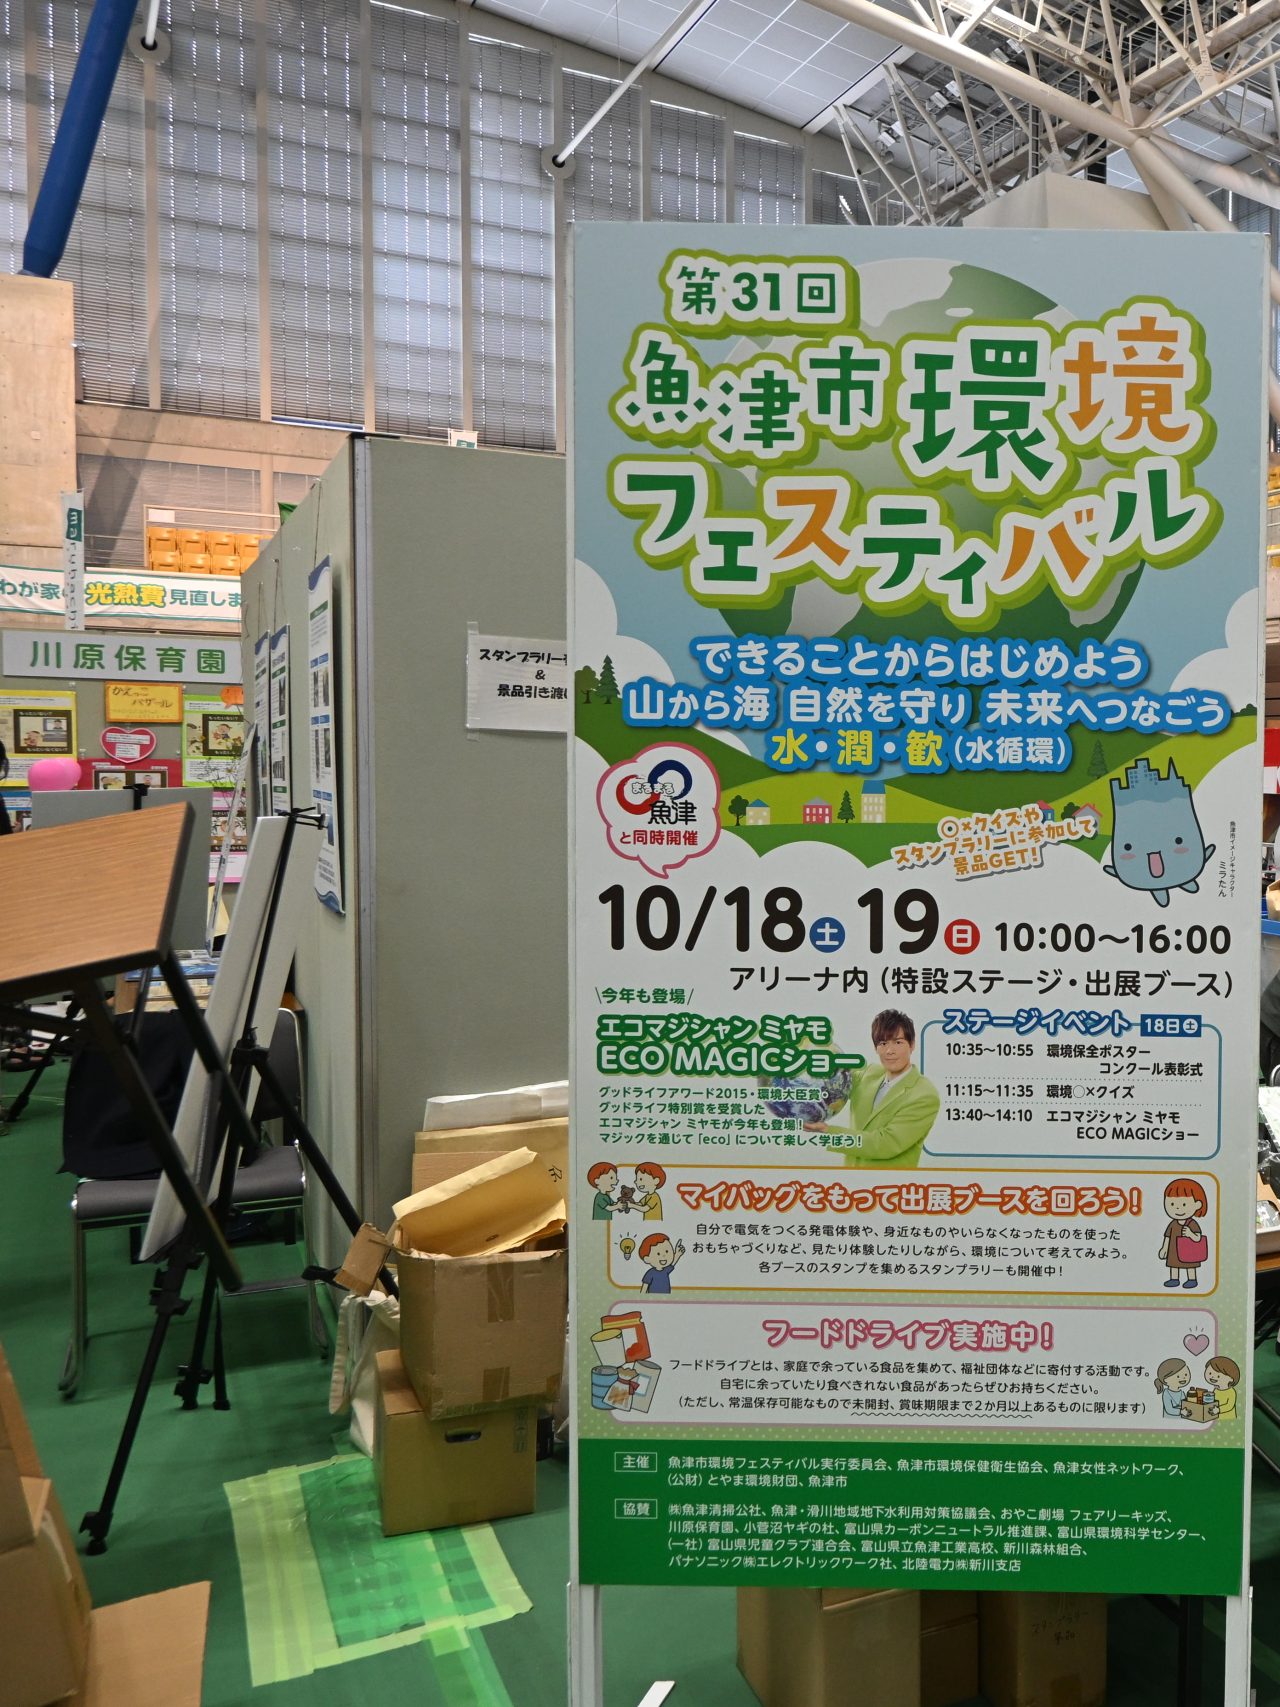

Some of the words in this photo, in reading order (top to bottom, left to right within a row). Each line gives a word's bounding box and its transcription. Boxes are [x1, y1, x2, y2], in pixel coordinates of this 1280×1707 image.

[677, 266, 836, 315] 第31回
[625, 315, 1191, 480] 魚津市環境
[626, 468, 1200, 607] フェスティバル
[30, 640, 226, 675] 川原保育園
[480, 648, 567, 666] スタンプラリー
[697, 641, 1143, 680] できることからはじめよう
[535, 669, 546, 680] &
[627, 684, 771, 720] 山から海
[788, 684, 969, 726] 自然を守り
[985, 690, 1231, 728] 未来へつなごう
[631, 781, 675, 795] まるまる
[648, 799, 698, 826] 魚津
[620, 829, 699, 846] と同時開催
[894, 819, 1093, 865] スタンプラリーに参加して
[953, 846, 1039, 876] 景品GET!
[1218, 861, 1227, 898] ミラたん
[601, 987, 687, 1005] 今年も登場
[600, 1017, 753, 1041] エコマジシャン
[763, 1018, 828, 1041] ミヤモ
[944, 1009, 1132, 1036] ステージイベント
[600, 1045, 665, 1071] ECO
[674, 1047, 860, 1074] MAGICショー
[1046, 1044, 1151, 1058] 環境保全ポスター
[1100, 1062, 1203, 1077] コンクール表彰式
[599, 1103, 766, 1117] グッドライフ特別賞を受賞した
[1047, 1110, 1137, 1124] エコマジシャン
[599, 1118, 681, 1130] エコマジシャン
[1076, 1127, 1107, 1140] ECO
[1112, 1127, 1200, 1142] MAGICショー
[762, 1318, 1053, 1352] フードドライブ実施中!
[622, 1455, 650, 1469] 主催
[622, 1502, 651, 1517] 協賛
